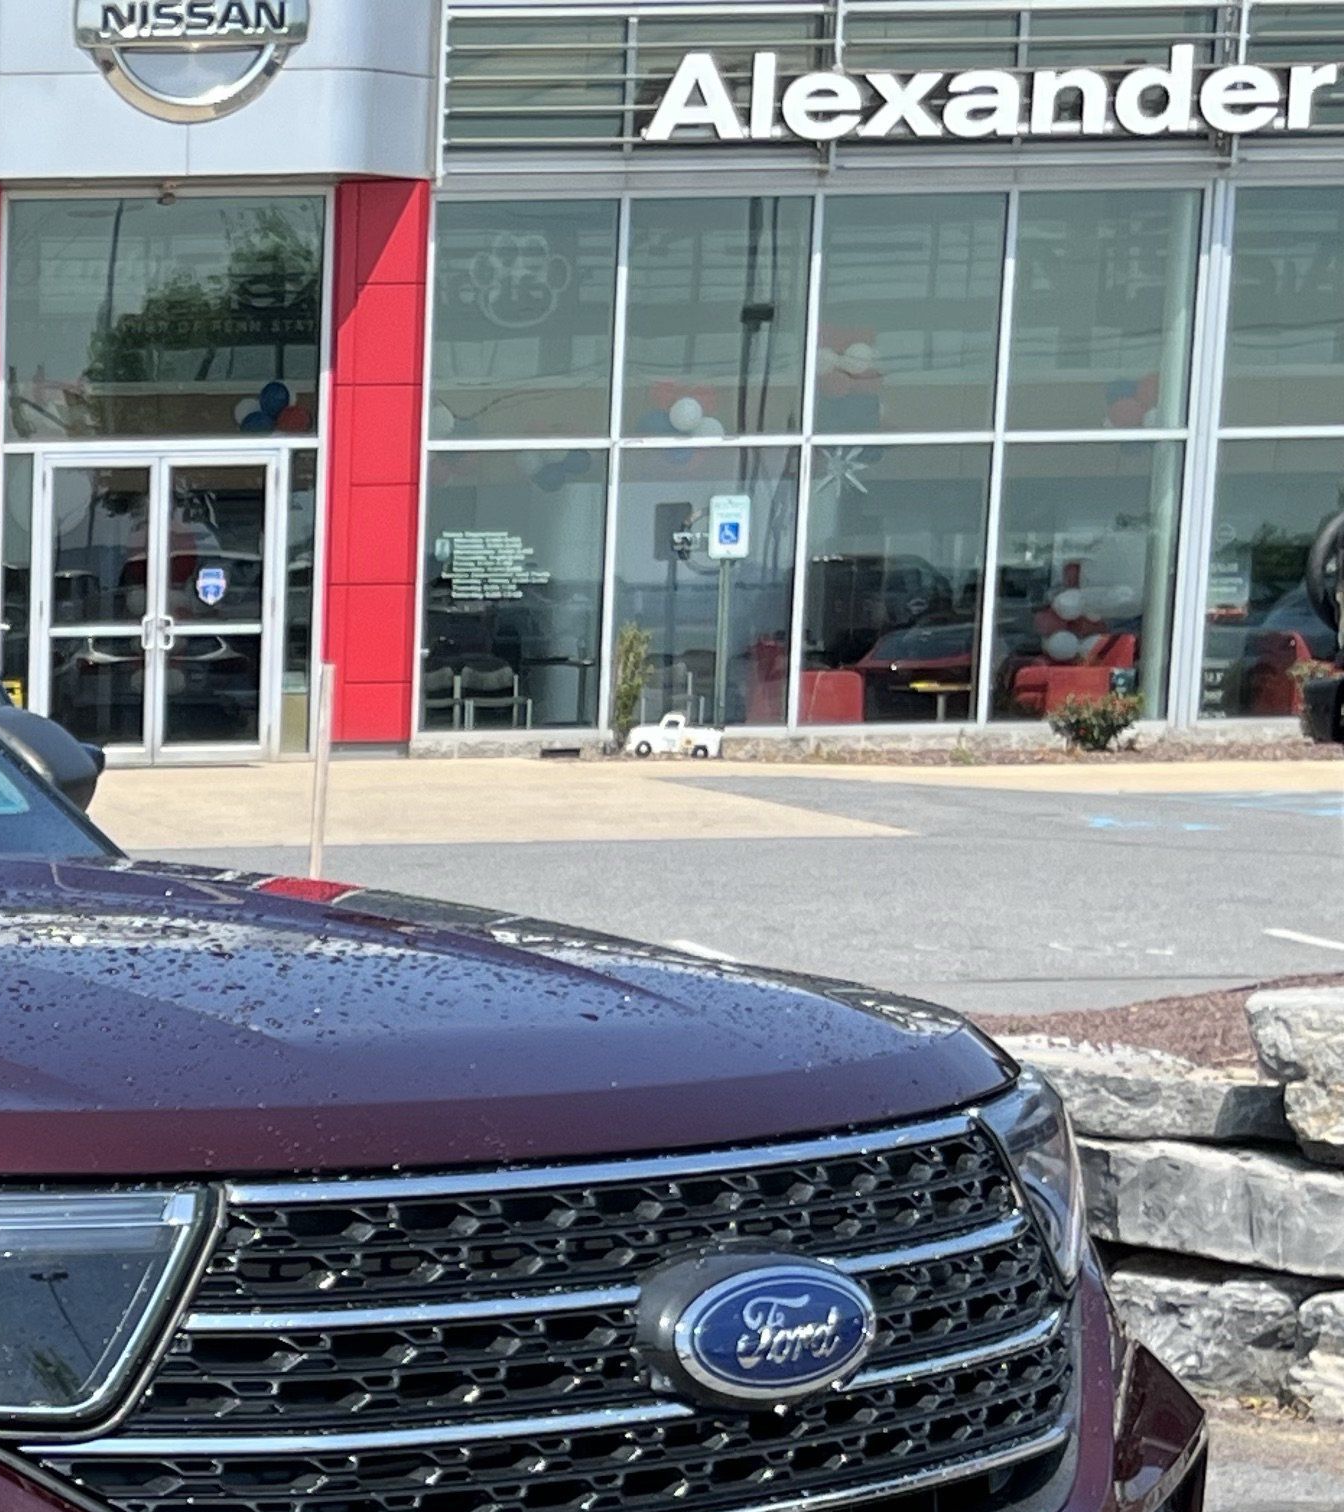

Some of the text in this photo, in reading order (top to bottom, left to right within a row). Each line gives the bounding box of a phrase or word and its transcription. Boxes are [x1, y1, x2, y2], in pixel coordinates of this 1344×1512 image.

[100, 0, 288, 38] NISSAN
[643, 44, 1338, 142] Alexander
[737, 1294, 841, 1370] Ford
